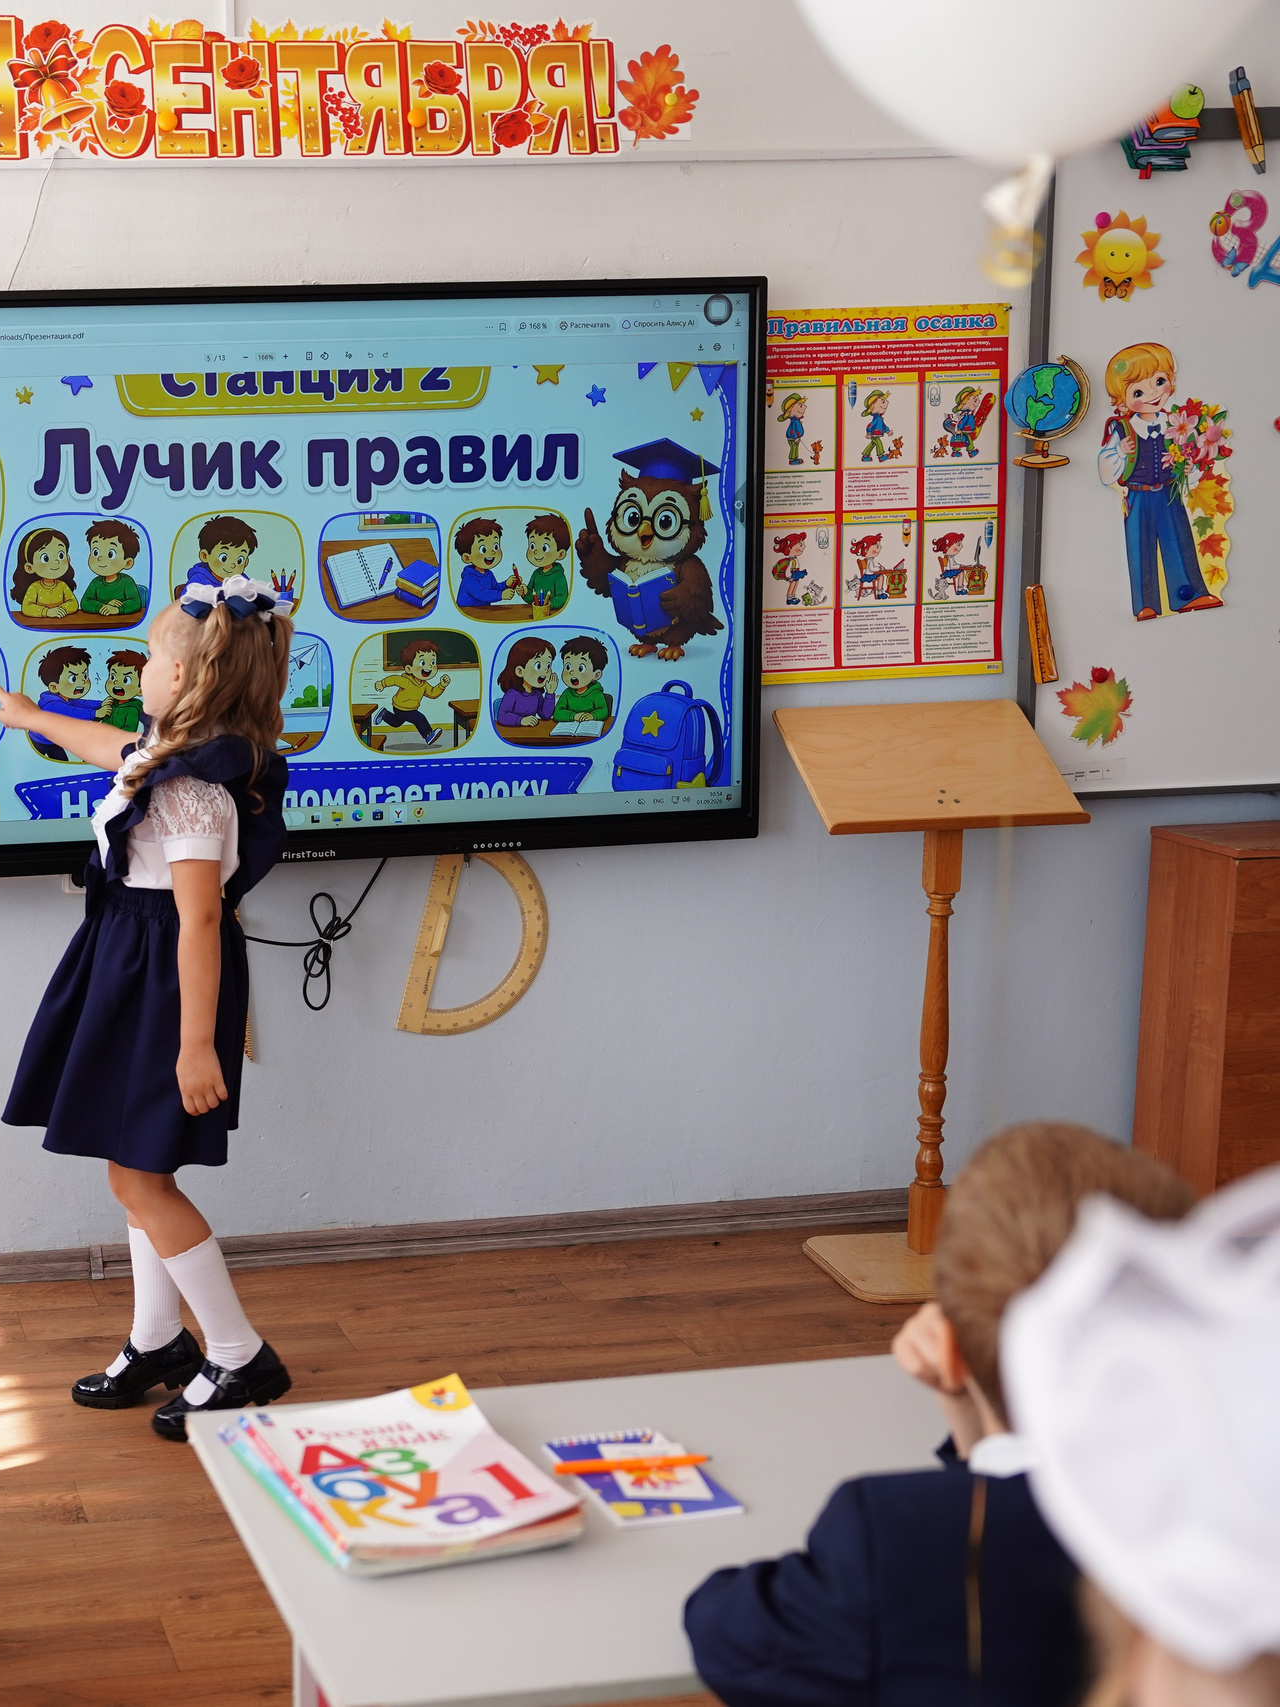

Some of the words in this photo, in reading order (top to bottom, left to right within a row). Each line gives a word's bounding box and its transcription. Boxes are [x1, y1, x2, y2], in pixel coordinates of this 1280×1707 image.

[89, 24, 622, 160] СЕНТЯБРЯ!
[570, 321, 611, 330] Распечатать
[633, 320, 665, 329] Спросить
[767, 317, 907, 338] Правильная
[916, 314, 997, 331] осанка
[33, 426, 285, 511] Лучик
[306, 432, 581, 503] правил
[282, 849, 336, 860] FirstTouch
